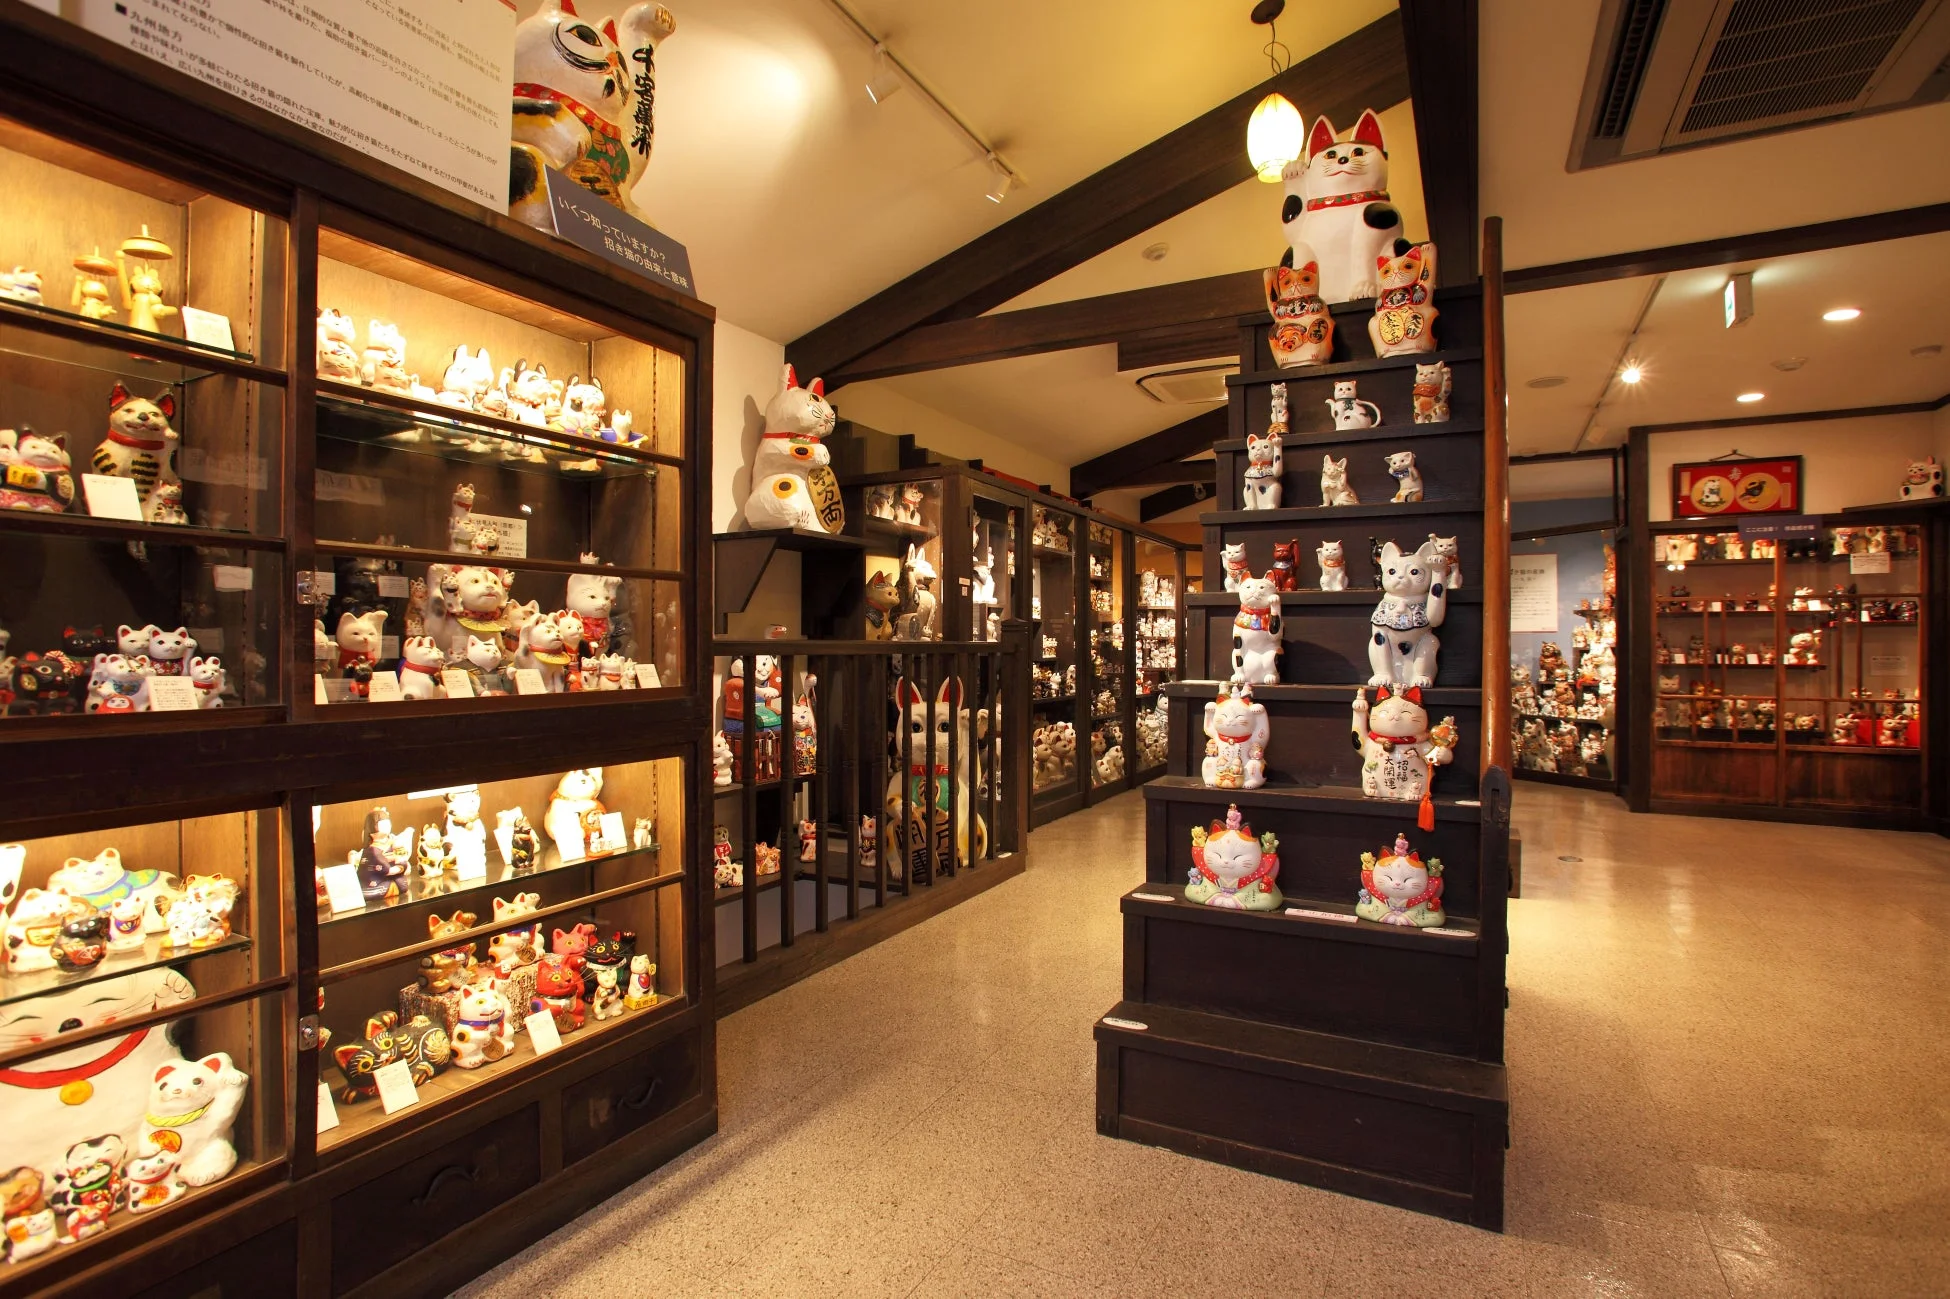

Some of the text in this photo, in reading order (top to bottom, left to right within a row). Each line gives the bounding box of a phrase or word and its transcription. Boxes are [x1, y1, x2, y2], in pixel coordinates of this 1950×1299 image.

[604, 236, 689, 289] 招き猫の由来と意味
